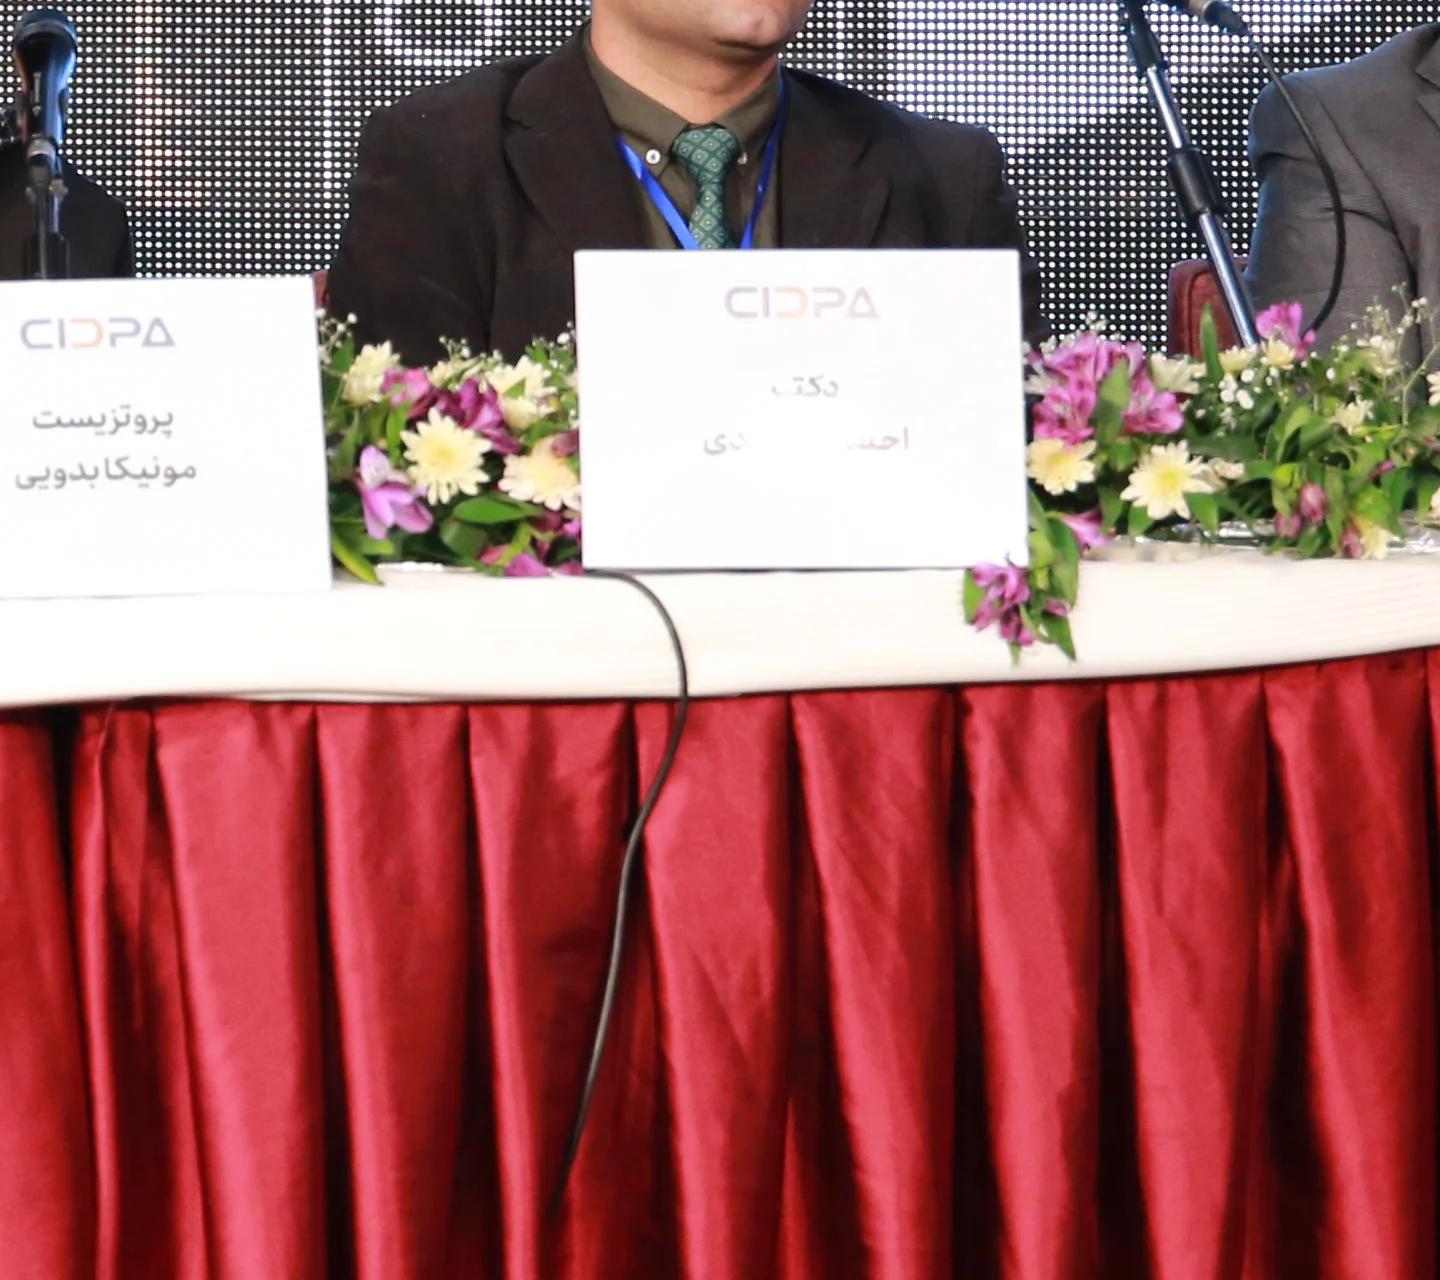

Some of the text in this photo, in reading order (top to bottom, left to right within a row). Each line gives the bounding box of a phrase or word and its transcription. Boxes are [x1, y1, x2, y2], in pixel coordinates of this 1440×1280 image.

[724, 286, 880, 319] CIDPA
[19, 316, 176, 350] CIDPA
[32, 404, 173, 439] پروتزیست
[15, 455, 196, 490] مونیکا بدویی
